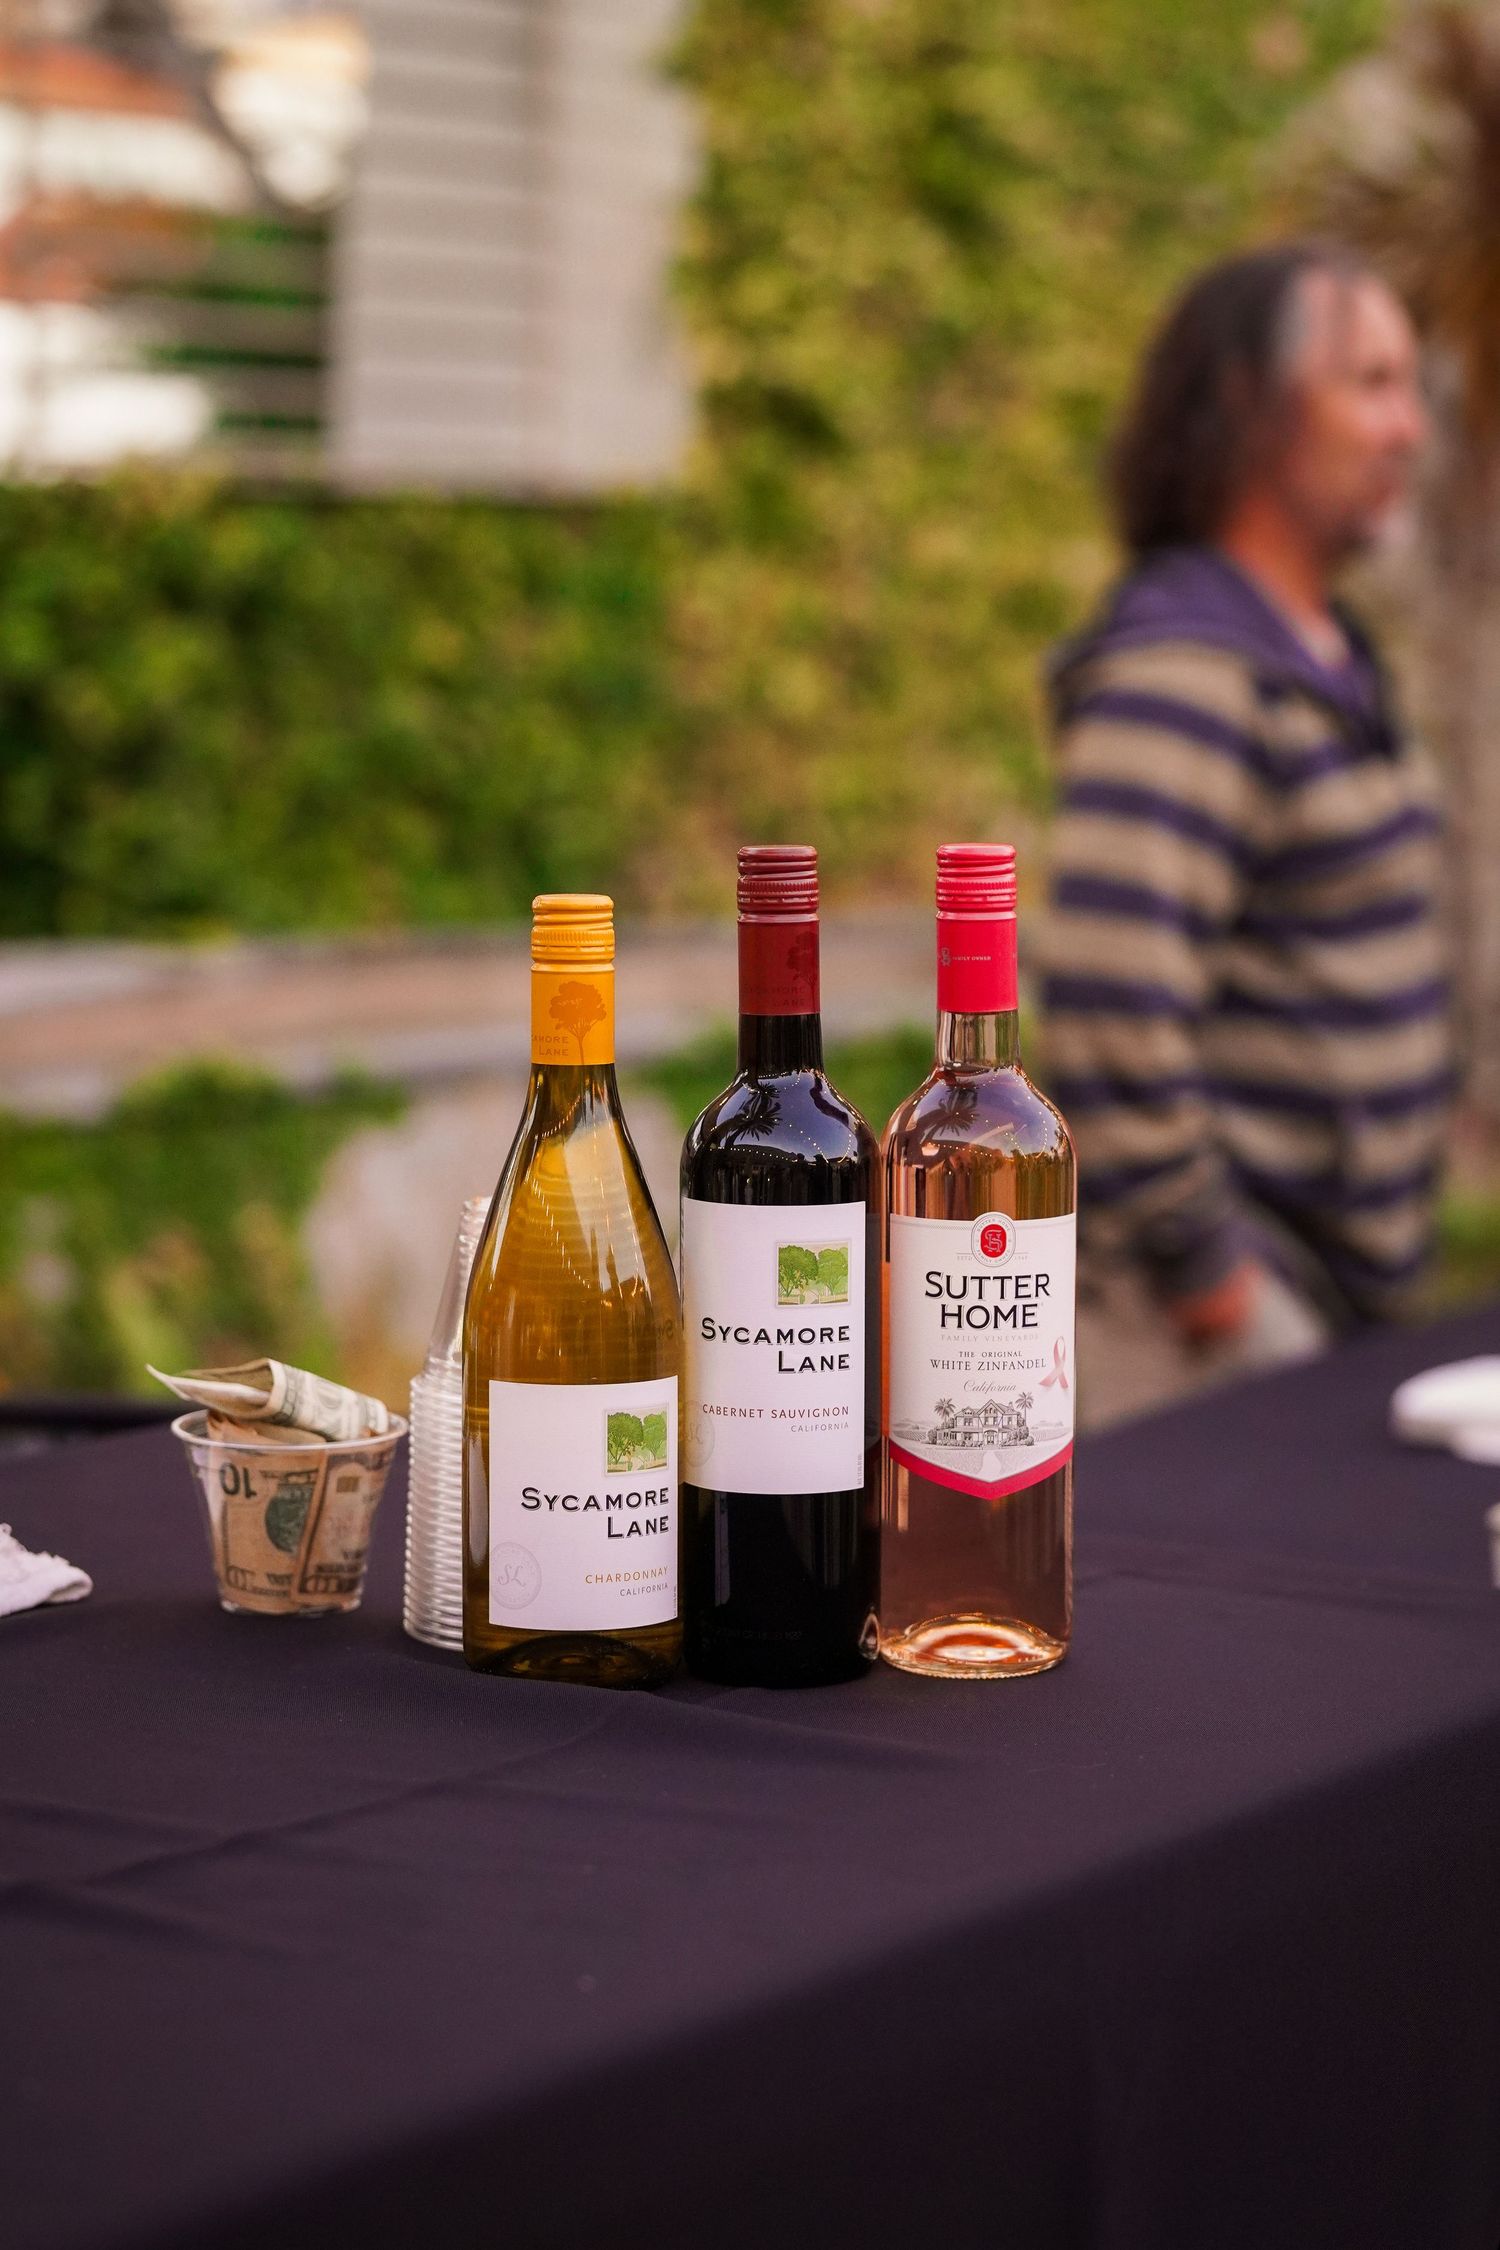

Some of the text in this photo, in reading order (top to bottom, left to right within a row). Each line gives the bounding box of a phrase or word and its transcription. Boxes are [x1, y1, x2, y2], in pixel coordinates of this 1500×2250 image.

[539, 1045, 569, 1057] LANE
[925, 1271, 1051, 1300] SUTTER
[940, 1303, 1039, 1330] HOME
[701, 1316, 851, 1346] SYCAMORE
[778, 1350, 851, 1374] LANE
[930, 1358, 1047, 1371] WHITE ZINFANDEL
[963, 1379, 1018, 1395] California
[702, 1403, 849, 1419] CABERNET SAUVIGNON
[790, 1421, 849, 1433] CALIFORNIA
[521, 1486, 670, 1512] SYCAMORE
[607, 1515, 670, 1539] LANE
[584, 1565, 669, 1584] CHARDONNAY
[619, 1583, 669, 1597] CALIFORNIA
